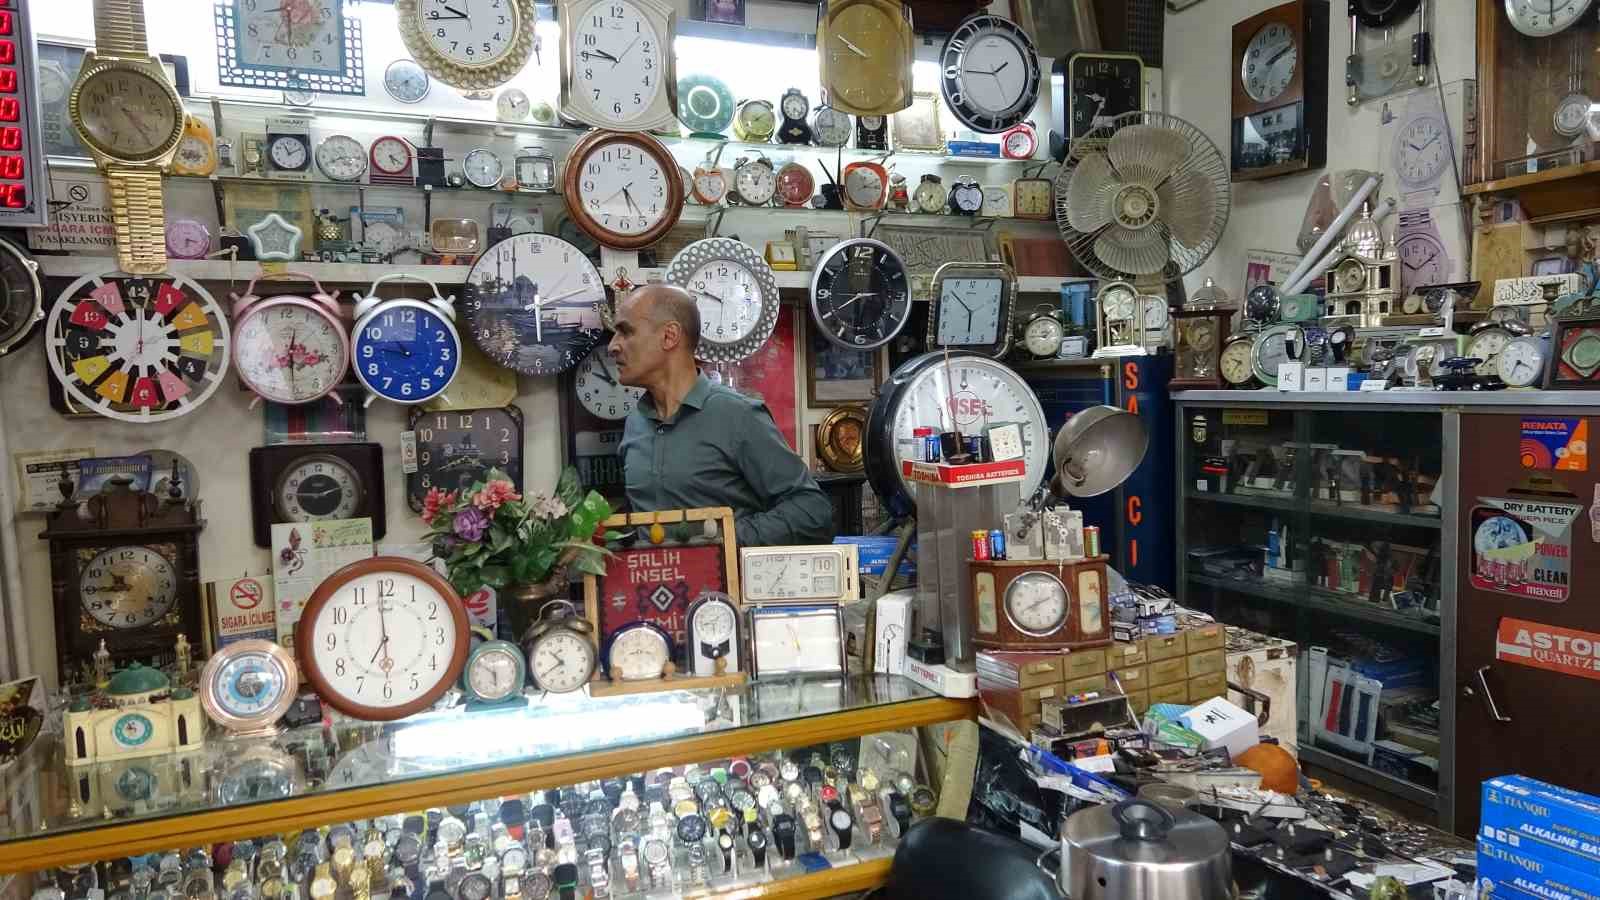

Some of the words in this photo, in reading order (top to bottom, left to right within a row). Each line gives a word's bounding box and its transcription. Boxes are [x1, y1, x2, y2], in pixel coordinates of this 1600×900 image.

[430, 10, 440, 20] 9
[610, 6, 624, 19] 12
[497, 15, 506, 25] 3
[593, 16, 603, 28] 11
[437, 28, 446, 38] 8
[635, 21, 640, 33] 1
[492, 32, 501, 41] 4
[584, 34, 597, 46] 10
[450, 41, 459, 51] 7
[465, 46, 475, 56] 6
[483, 42, 492, 53] 5
[642, 41, 651, 53] 2
[644, 59, 653, 70] 3
[584, 69, 593, 81] 8
[642, 75, 650, 87] 4
[593, 89, 601, 101] 7
[634, 93, 641, 105] 5
[613, 102, 621, 114] 6
[602, 151, 612, 162] 11
[618, 148, 632, 161] 12
[639, 153, 644, 165] 1
[588, 163, 601, 175] 10
[649, 168, 659, 180] 2
[583, 180, 595, 193] 9
[653, 186, 664, 197] 3
[590, 199, 600, 209] 8
[648, 201, 657, 214] 4
[601, 213, 611, 226] 7
[619, 218, 631, 230] 6
[638, 215, 648, 227] 5
[854, 246, 875, 259] 12
[705, 271, 713, 281] 11
[717, 267, 729, 278] 12
[131, 284, 149, 299] 12
[695, 280, 706, 291] 10
[165, 292, 173, 304] 1
[817, 288, 831, 300] 9
[473, 300, 482, 311] 9
[591, 302, 600, 313] 3
[84, 310, 100, 322] 10
[383, 314, 394, 329] 11
[400, 310, 417, 324] 12
[423, 316, 430, 329] 1
[704, 321, 711, 331] 7
[715, 326, 724, 336] 6
[366, 327, 383, 341] 10
[435, 330, 446, 343] 2
[483, 328, 492, 339] 8
[584, 328, 593, 338] 4
[854, 334, 867, 345] 6
[362, 345, 374, 359] 9
[440, 348, 451, 361] 3
[187, 360, 197, 373] 4
[367, 362, 379, 376] 8
[534, 358, 544, 368] 6
[433, 365, 446, 379] 4
[110, 382, 118, 394] 7
[383, 377, 393, 390] 7
[401, 383, 412, 396] 6
[420, 377, 431, 391] 5
[138, 389, 149, 401] 6
[436, 415, 448, 430] 11
[458, 414, 473, 429] 12
[484, 415, 491, 430] 1
[1520, 421, 1568, 432] RENATA
[419, 429, 433, 443] 10
[500, 427, 511, 443] 2
[421, 450, 432, 466] 9
[500, 450, 510, 466] 3
[421, 473, 432, 489] 8
[955, 472, 985, 482] TOSHIBA
[1503, 502, 1523, 512] DRY
[1526, 503, 1577, 516] BATTERY
[120, 551, 136, 561] 12
[1534, 542, 1569, 558] POWER
[626, 549, 681, 569] SALİH
[818, 558, 833, 572] 10
[89, 568, 102, 578] 10
[1533, 567, 1569, 586] CLEAN
[378, 579, 395, 598] 12
[410, 584, 417, 602] 1
[1525, 583, 1563, 600] maxell
[353, 587, 366, 605] 11
[332, 606, 347, 625] 10
[428, 600, 437, 621] 2
[125, 613, 137, 624] 6
[326, 631, 337, 652] 9
[435, 627, 445, 646] 3
[428, 653, 439, 672] 4
[1532, 648, 1594, 671] QUARTZ
[335, 656, 346, 678] 8
[356, 675, 366, 695] 7
[409, 672, 419, 692] 5
[383, 681, 393, 700] 6
[1503, 794, 1551, 818] TIANQIU
[1519, 822, 1580, 849] ALKALINE
[1494, 846, 1545, 874] TIANQIU
